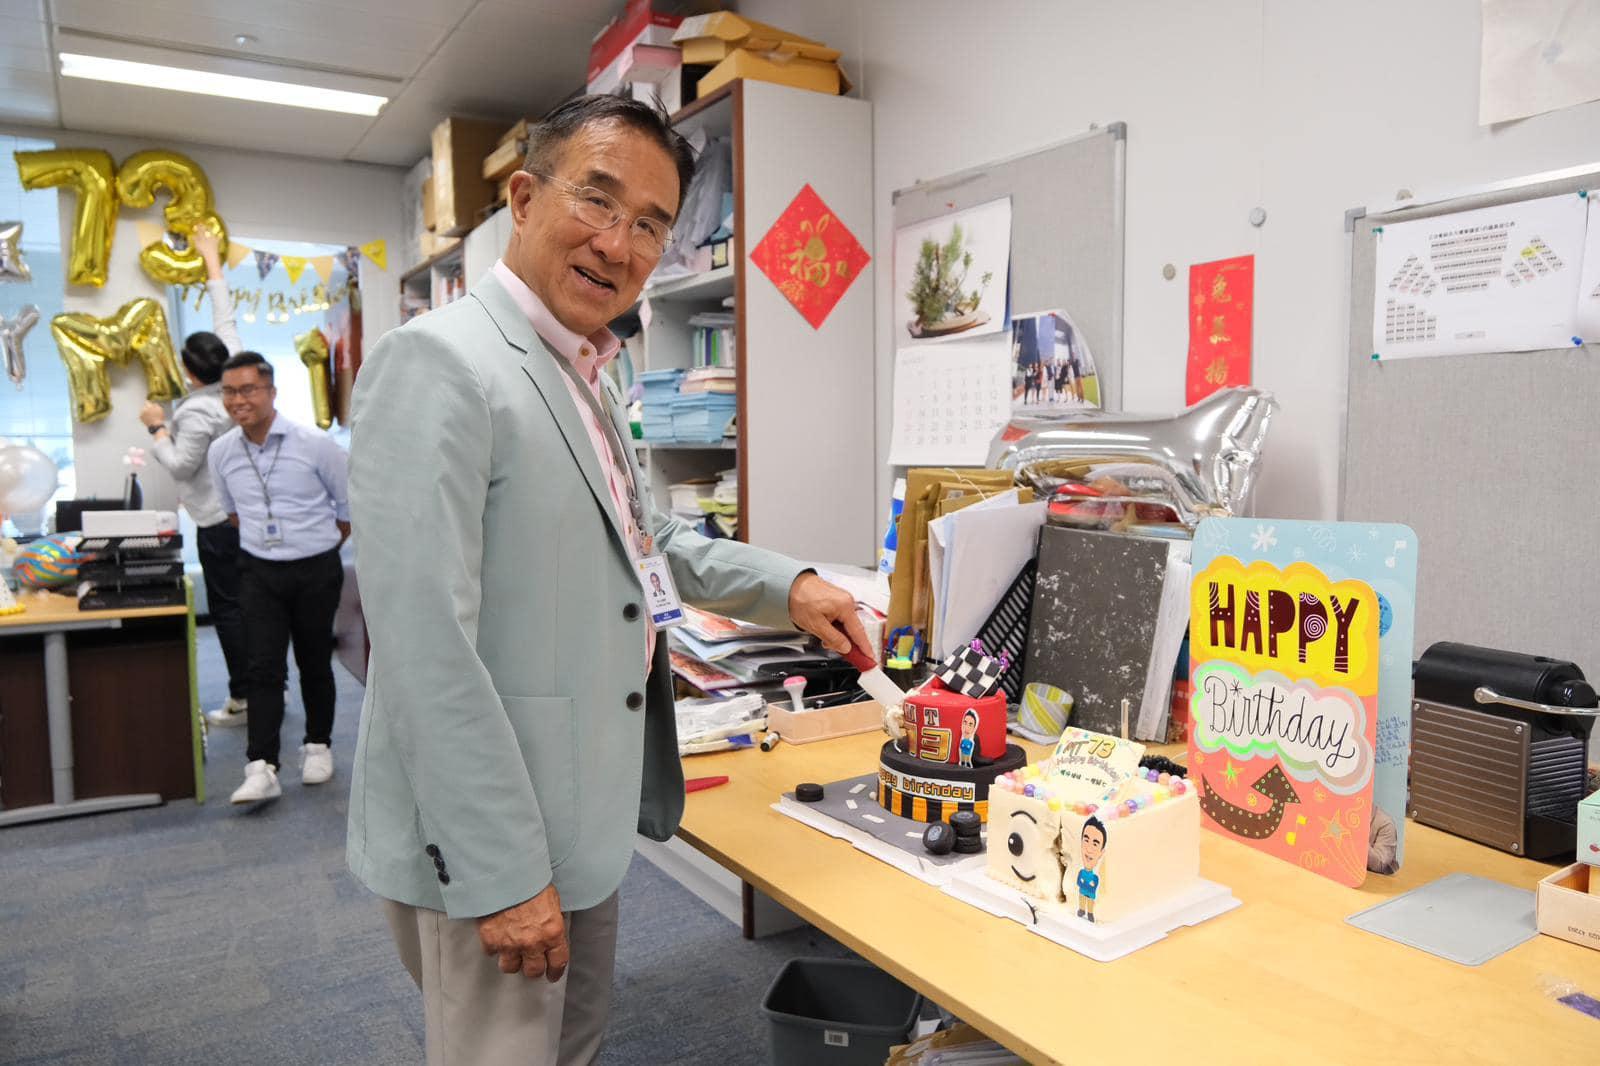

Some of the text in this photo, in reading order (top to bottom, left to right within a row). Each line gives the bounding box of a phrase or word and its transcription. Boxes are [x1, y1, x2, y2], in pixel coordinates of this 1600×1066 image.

[13, 148, 229, 287] 73
[1209, 582, 1360, 674] HAPPY
[1088, 735, 1116, 759] 73
[1204, 674, 1356, 768] Birthday
[903, 777, 974, 801] birthday
